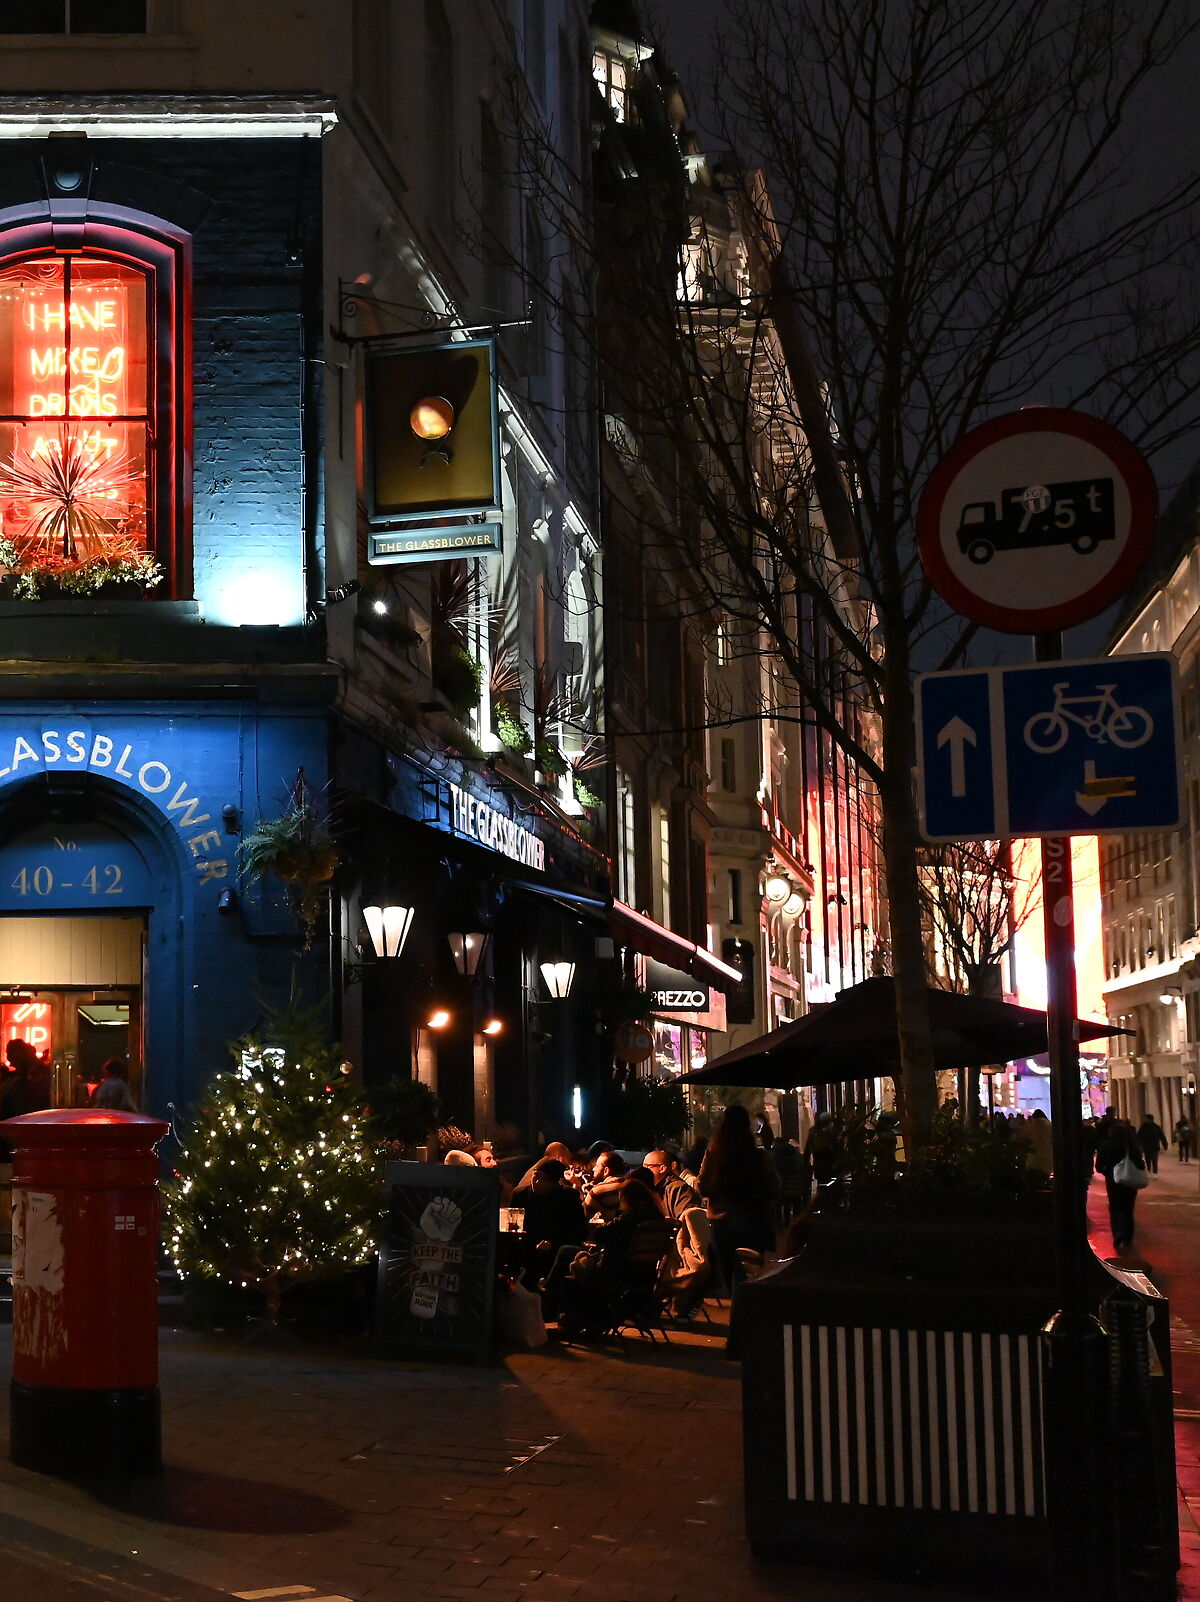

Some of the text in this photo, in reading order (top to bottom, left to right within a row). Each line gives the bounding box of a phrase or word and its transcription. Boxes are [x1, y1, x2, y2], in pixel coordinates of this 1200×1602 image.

[379, 535, 491, 553] THE GLASSBLOWER
[450, 782, 545, 872] THE GLASSBLOWER
[414, 1245, 461, 1261] KEEP THE
[411, 1271, 457, 1290] FAITH
